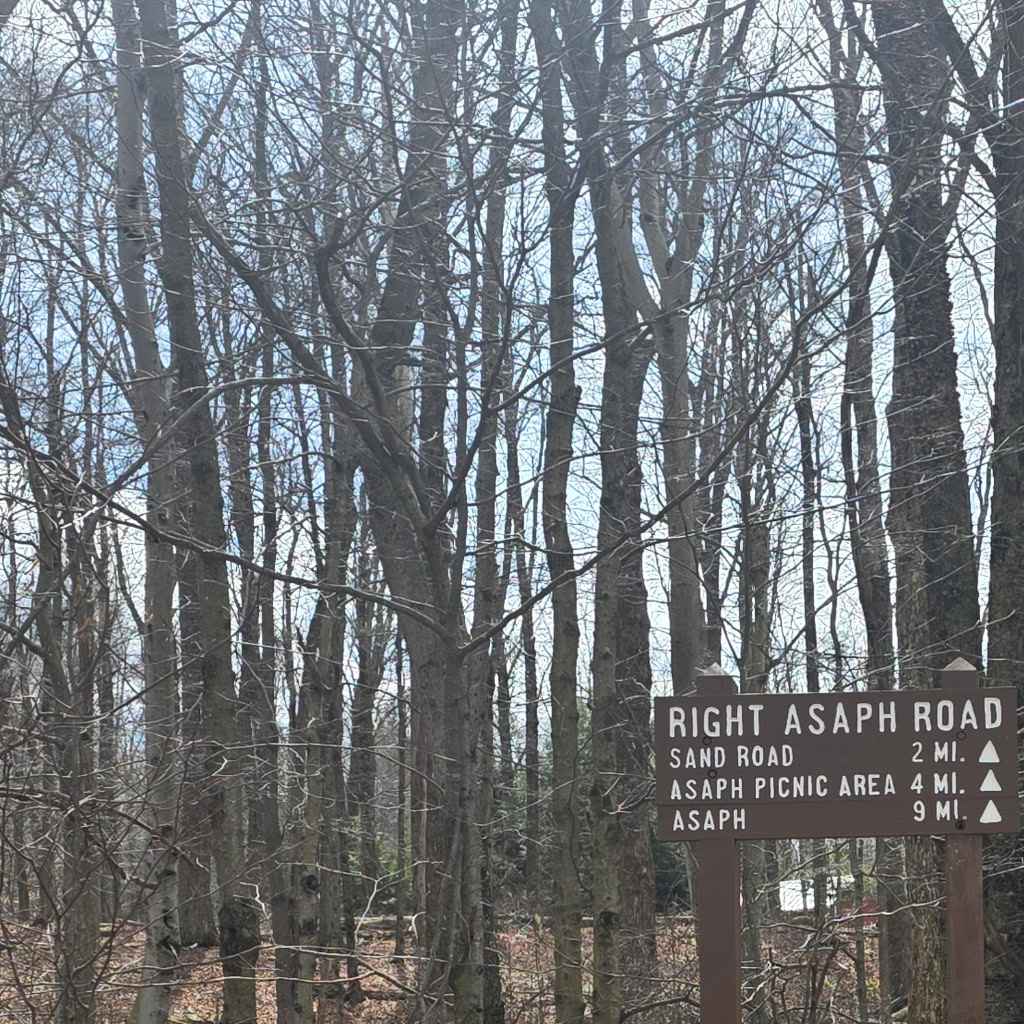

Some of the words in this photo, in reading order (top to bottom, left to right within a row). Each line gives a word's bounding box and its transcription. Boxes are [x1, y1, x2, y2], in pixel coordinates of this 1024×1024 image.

[669, 704, 765, 738] RIGHT
[784, 701, 898, 736] ASAPH
[913, 697, 1002, 733] ROAD
[669, 746, 726, 769] SAND
[736, 745, 794, 767] ROAD
[911, 741, 924, 763] 2
[934, 740, 966, 763] MI.
[670, 777, 743, 801] ASAPH
[755, 775, 829, 799] PICNIC
[839, 773, 896, 797] AREA
[910, 772, 924, 795] 4
[933, 771, 966, 795] MI.
[672, 808, 746, 832] ASAPH
[913, 800, 926, 822] 9
[935, 798, 968, 822] MI.
